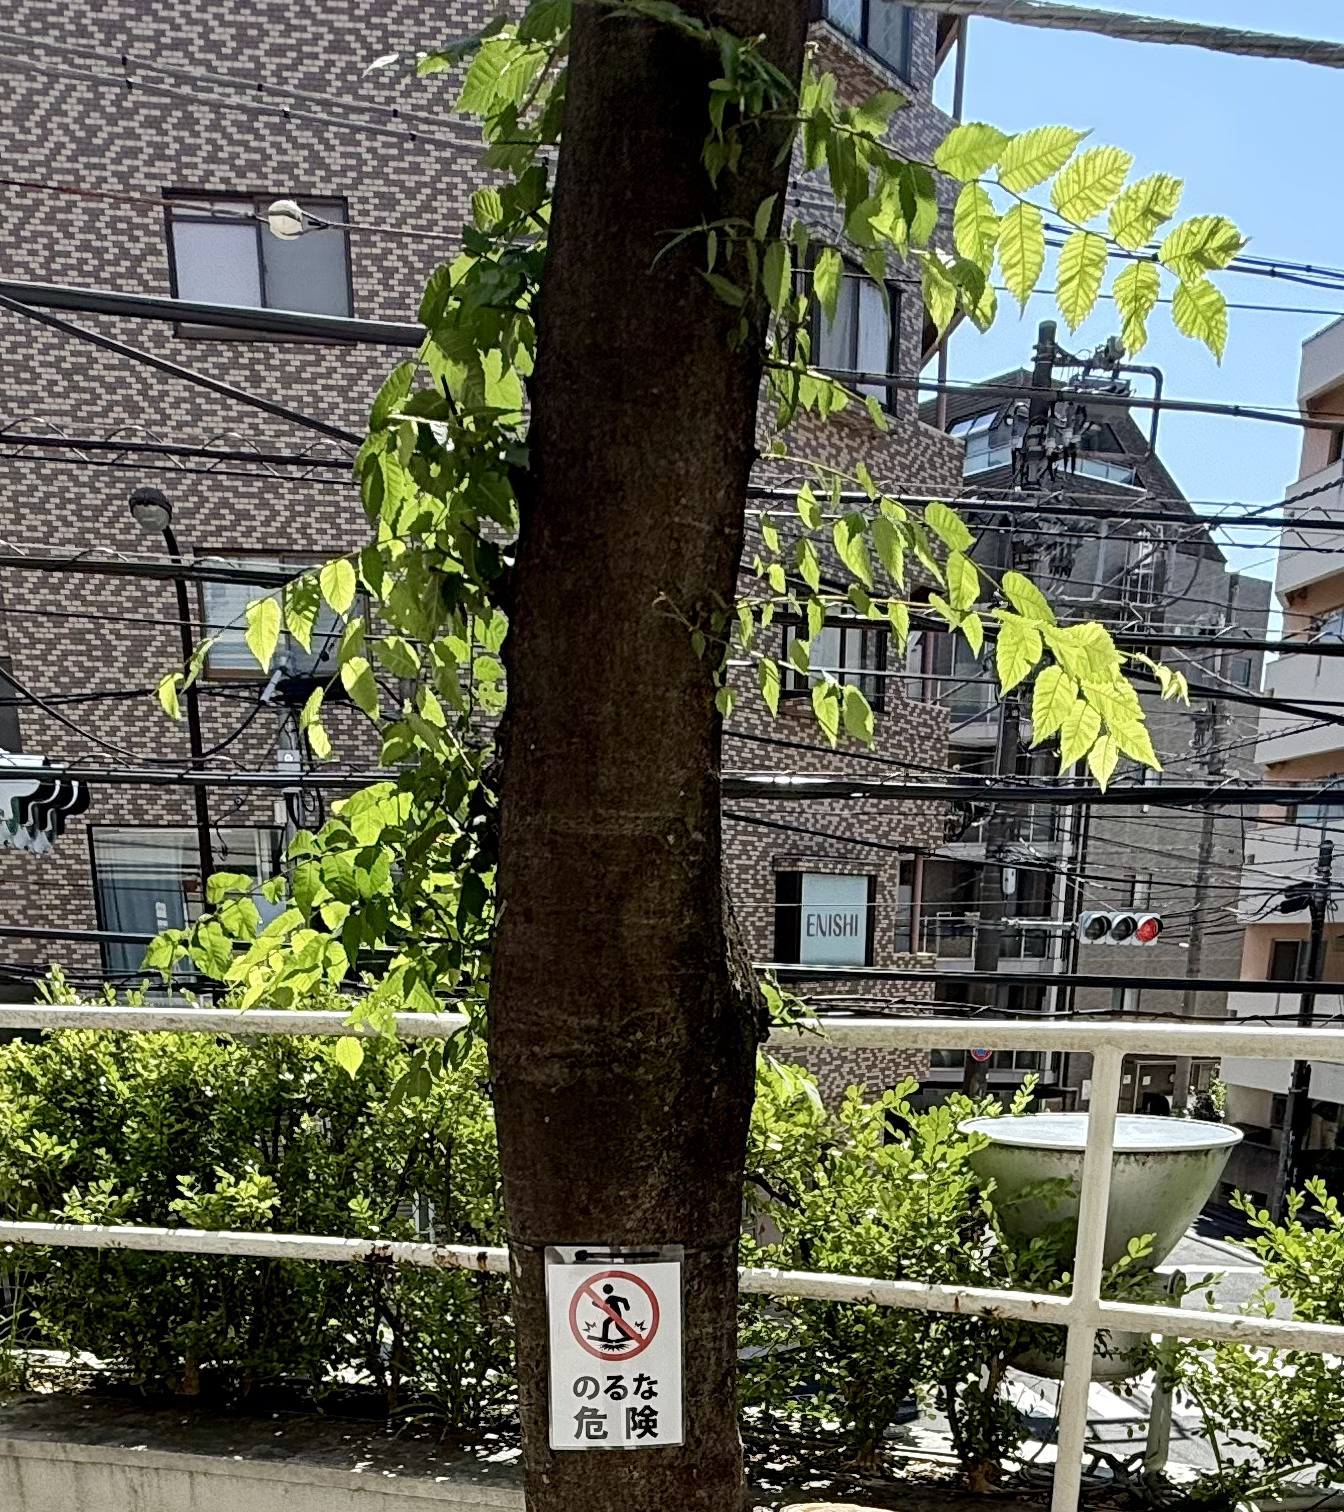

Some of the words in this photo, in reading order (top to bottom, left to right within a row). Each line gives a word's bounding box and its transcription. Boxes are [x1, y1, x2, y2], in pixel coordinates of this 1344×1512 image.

[807, 914, 858, 937] ENISHI
[573, 1373, 658, 1401] のるな
[573, 1405, 659, 1440] 危険
